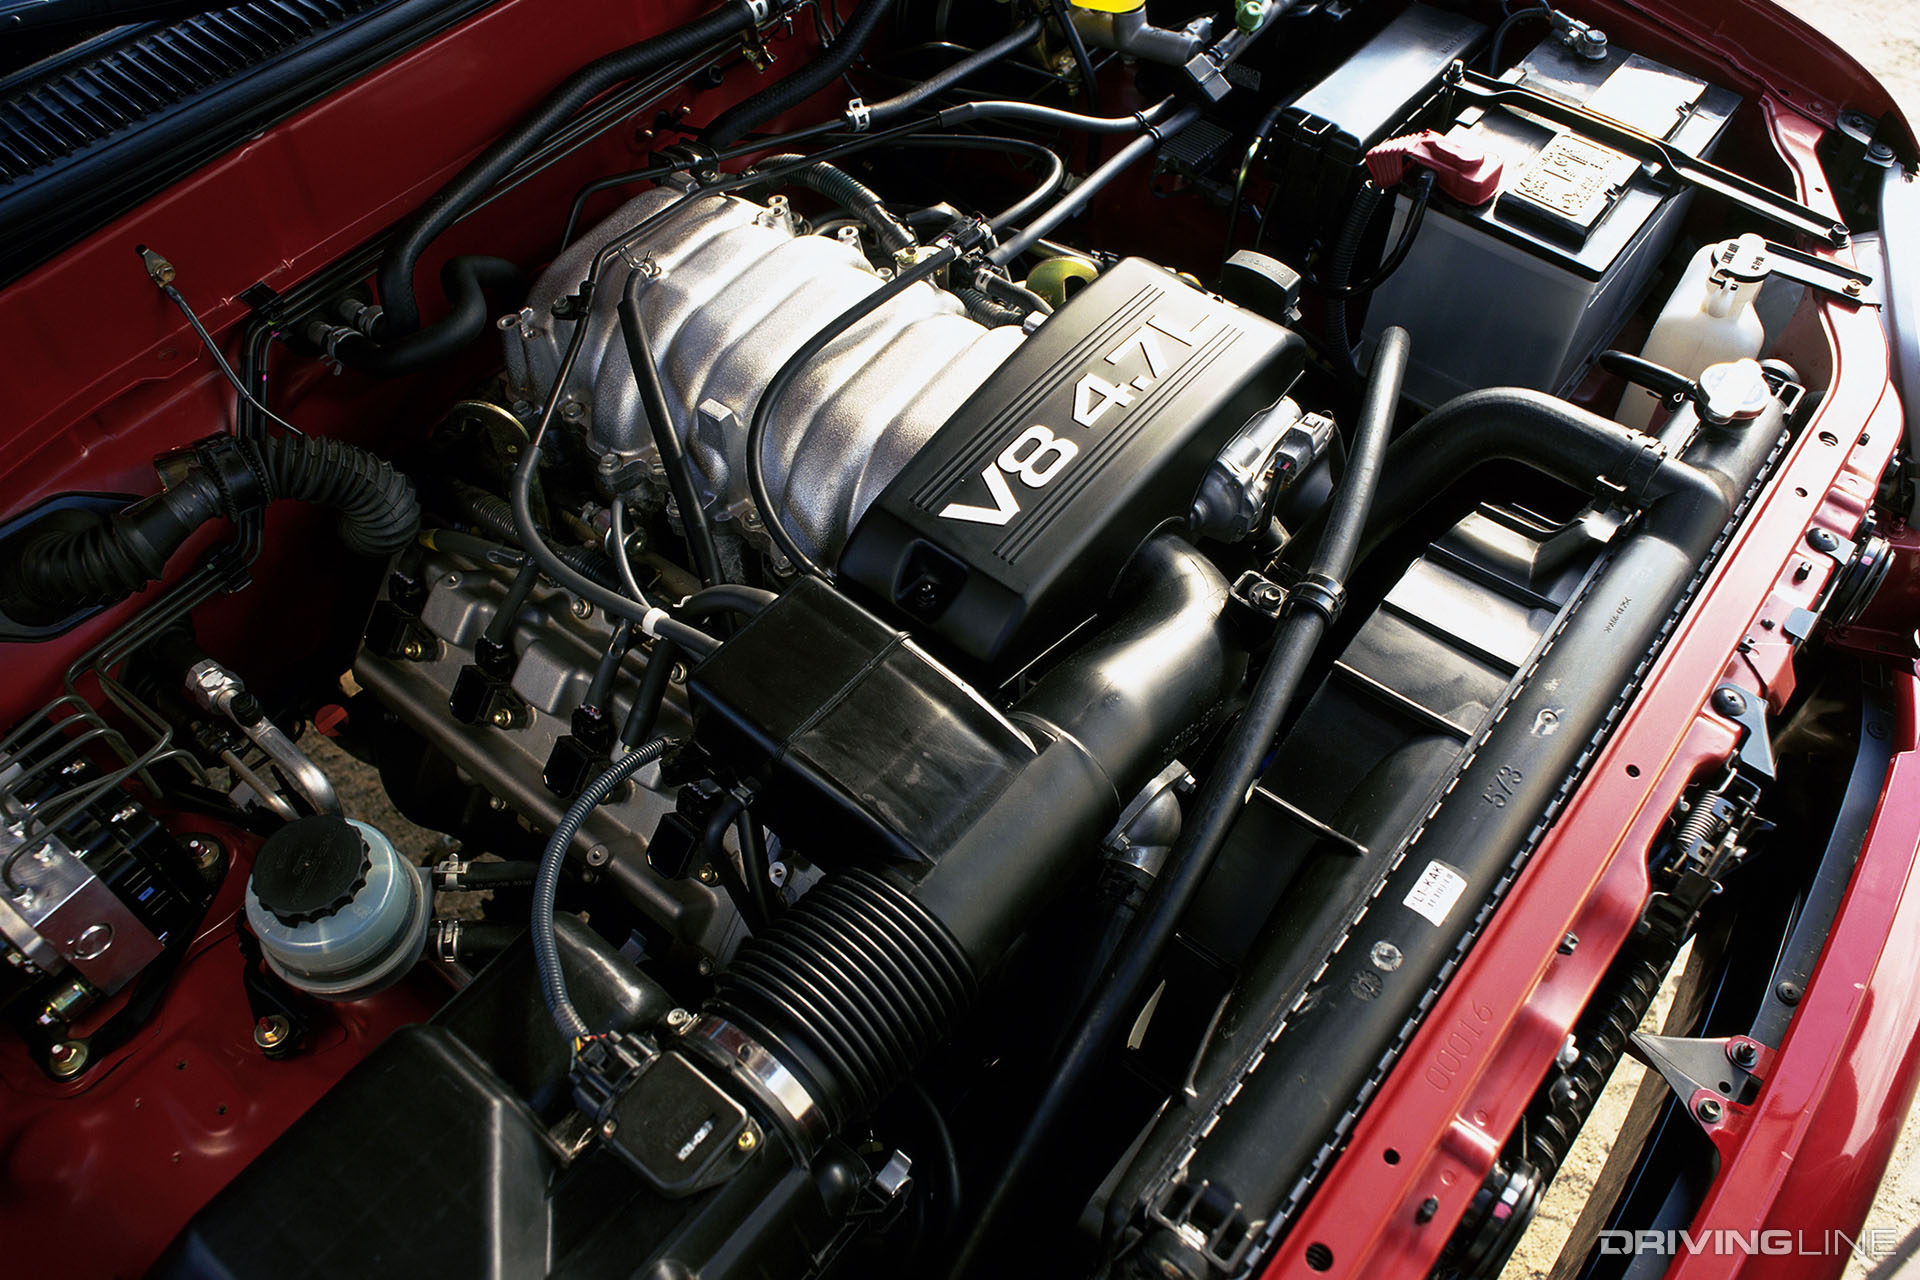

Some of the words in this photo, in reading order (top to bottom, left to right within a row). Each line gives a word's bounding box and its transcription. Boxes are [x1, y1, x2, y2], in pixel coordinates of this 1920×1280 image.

[938, 424, 1079, 526] V8
[1072, 314, 1210, 428] 4.7L
[1425, 1000, 1493, 1093] 00016
